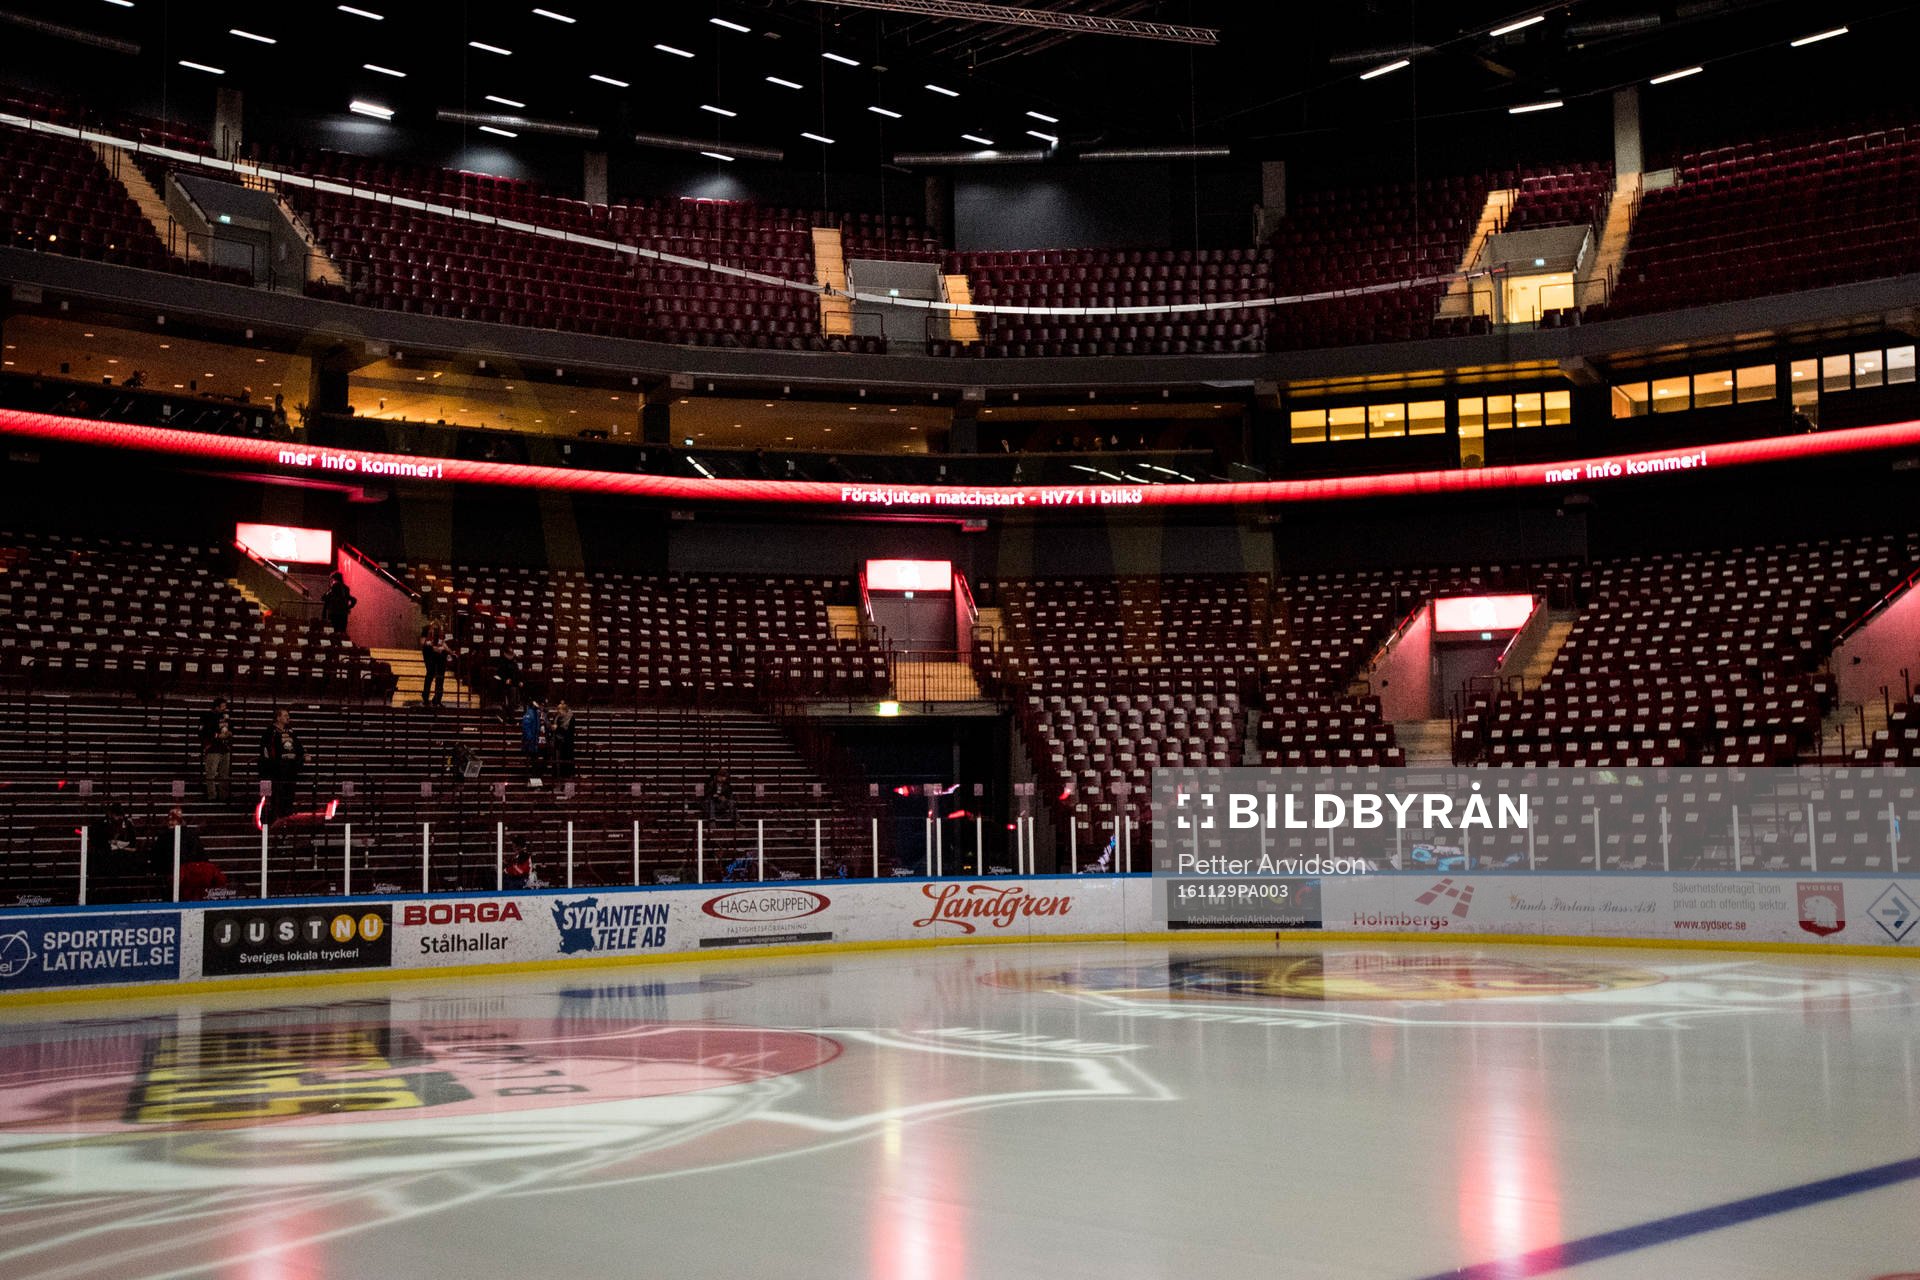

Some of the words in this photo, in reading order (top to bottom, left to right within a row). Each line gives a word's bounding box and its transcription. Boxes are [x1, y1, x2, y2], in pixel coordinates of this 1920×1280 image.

[279, 450, 317, 466] mer
[321, 452, 357, 472] info
[361, 457, 443, 479] kommer!
[1545, 465, 1580, 482] mer
[1586, 461, 1622, 478] info
[1627, 450, 1707, 475] kommer!
[841, 486, 931, 505] Förskjuten
[936, 490, 1025, 505] matchstart
[1041, 489, 1084, 504] HV71
[1100, 488, 1142, 504] bilkö
[1672, 882, 1756, 896] Säkerhetsföretaget
[1758, 882, 1781, 895] inom
[403, 901, 523, 926] BORGA
[720, 899, 758, 913] HAGA
[759, 896, 814, 913] GRUPPEN
[912, 883, 1072, 933] Landgren
[1673, 899, 1697, 911] privat
[1700, 899, 1716, 910] och
[1719, 899, 1756, 912] offentlig
[1758, 899, 1790, 911] sektor.
[1354, 912, 1449, 930] Holmbergs
[1674, 919, 1747, 932] www.sydsec.se
[43, 927, 175, 950] SPORTRESOR
[420, 933, 509, 955] Stålhallar
[598, 927, 639, 951] TELE
[641, 925, 666, 949] AB
[43, 947, 175, 971] LATRAVEL.SE
[239, 951, 285, 965] Sveriges
[287, 950, 319, 962] lokala
[320, 949, 359, 961] tryckeri
